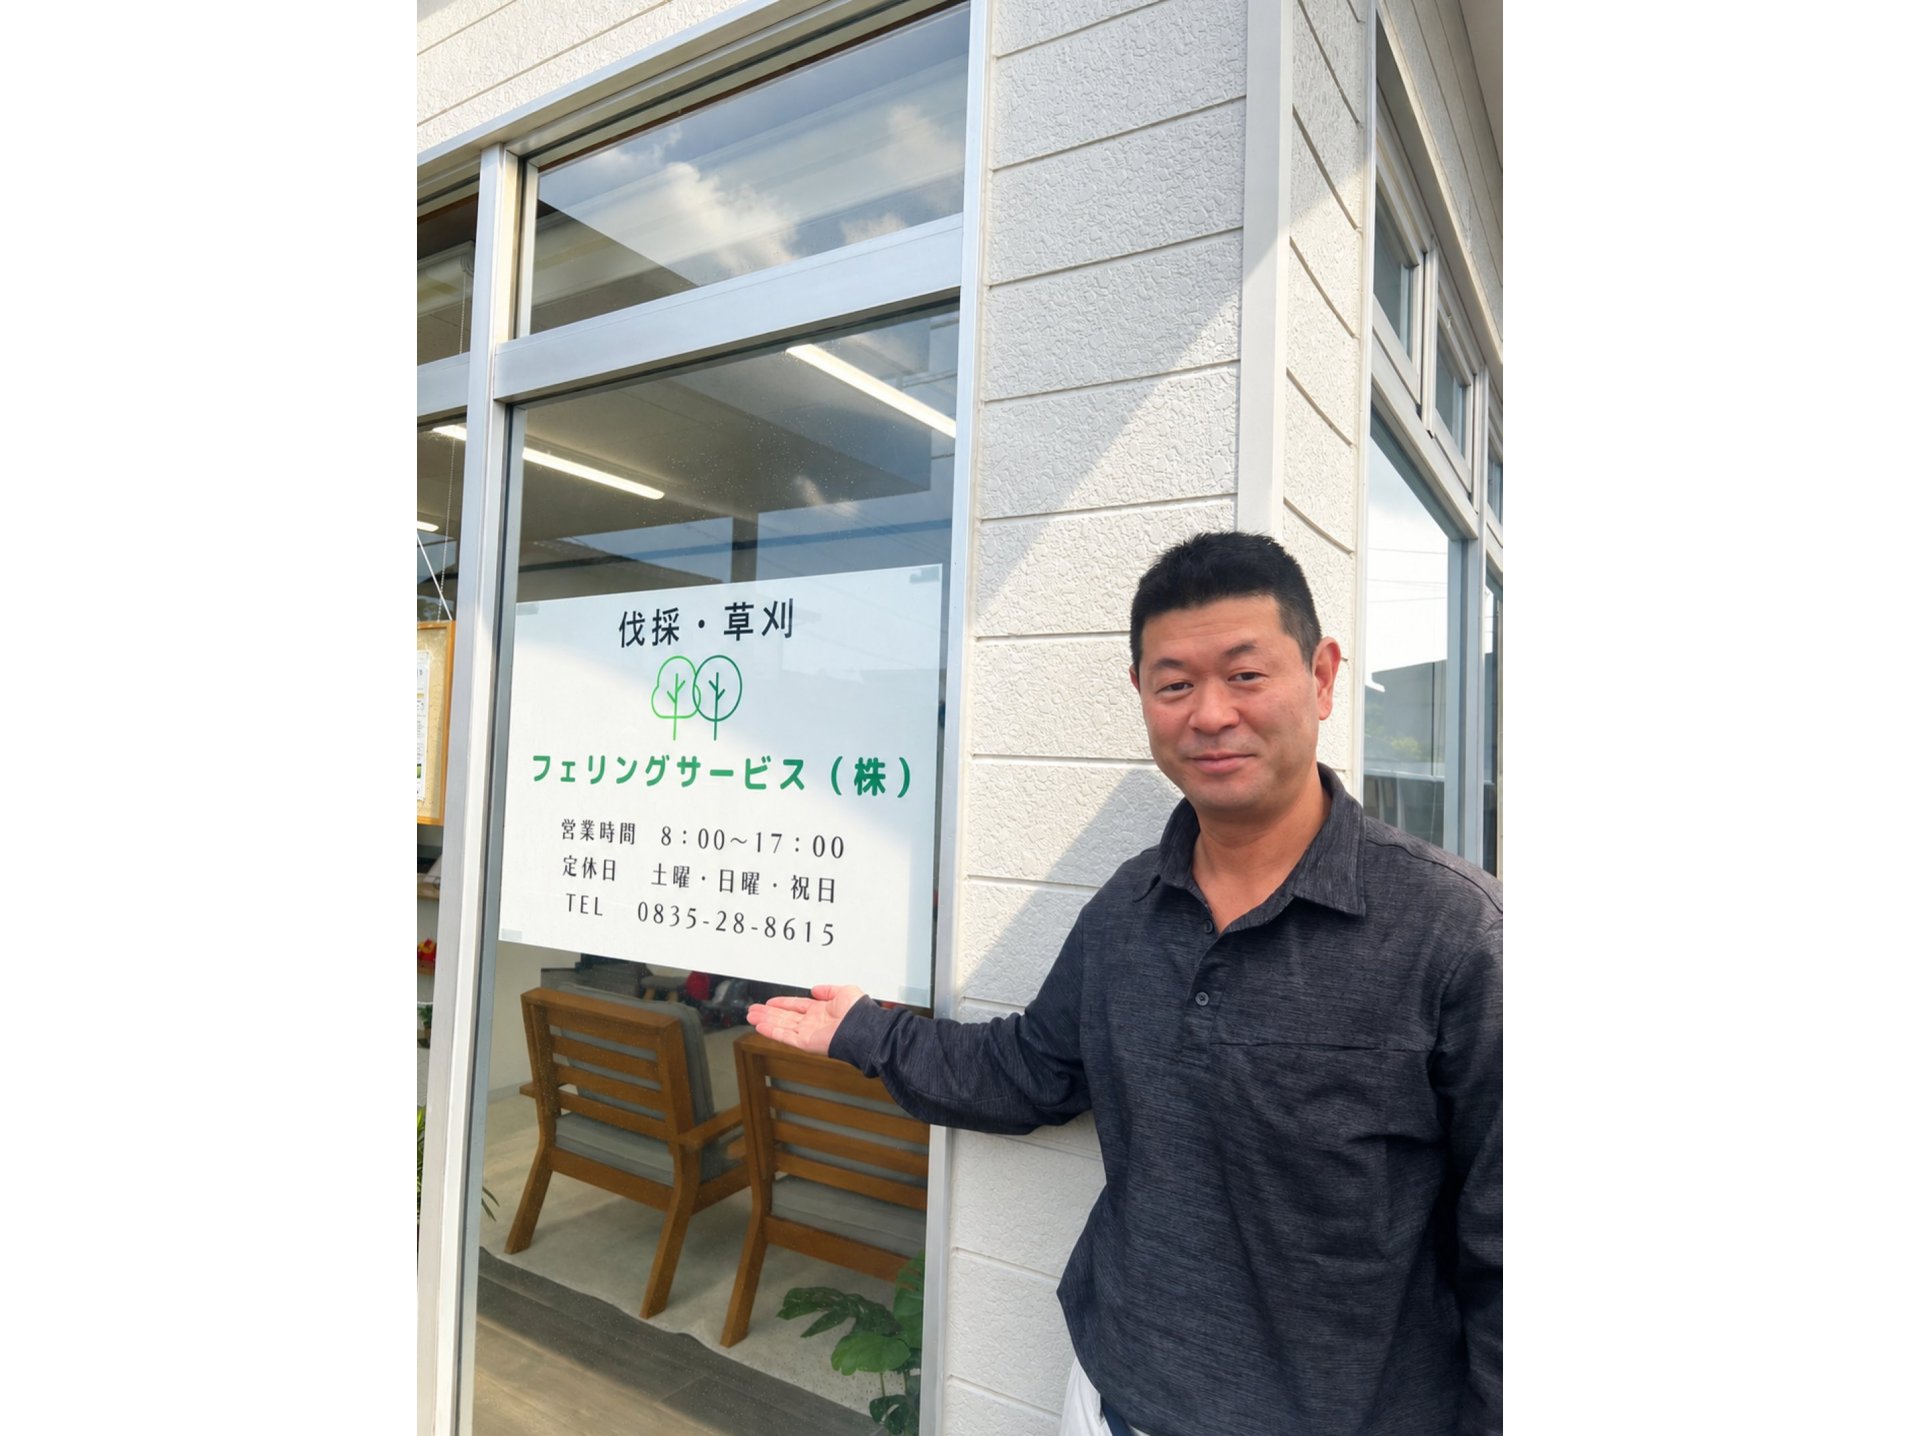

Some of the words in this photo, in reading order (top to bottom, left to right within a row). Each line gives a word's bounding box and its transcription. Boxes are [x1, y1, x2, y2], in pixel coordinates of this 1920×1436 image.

[618, 597, 794, 648] 伐採・草刈
[560, 818, 637, 846] 営業時間
[561, 854, 617, 882] 定休日
[651, 862, 836, 904] 土曜・日曜・祝日
[565, 892, 604, 917] TEL
[637, 901, 835, 947] 0835-28-8615
